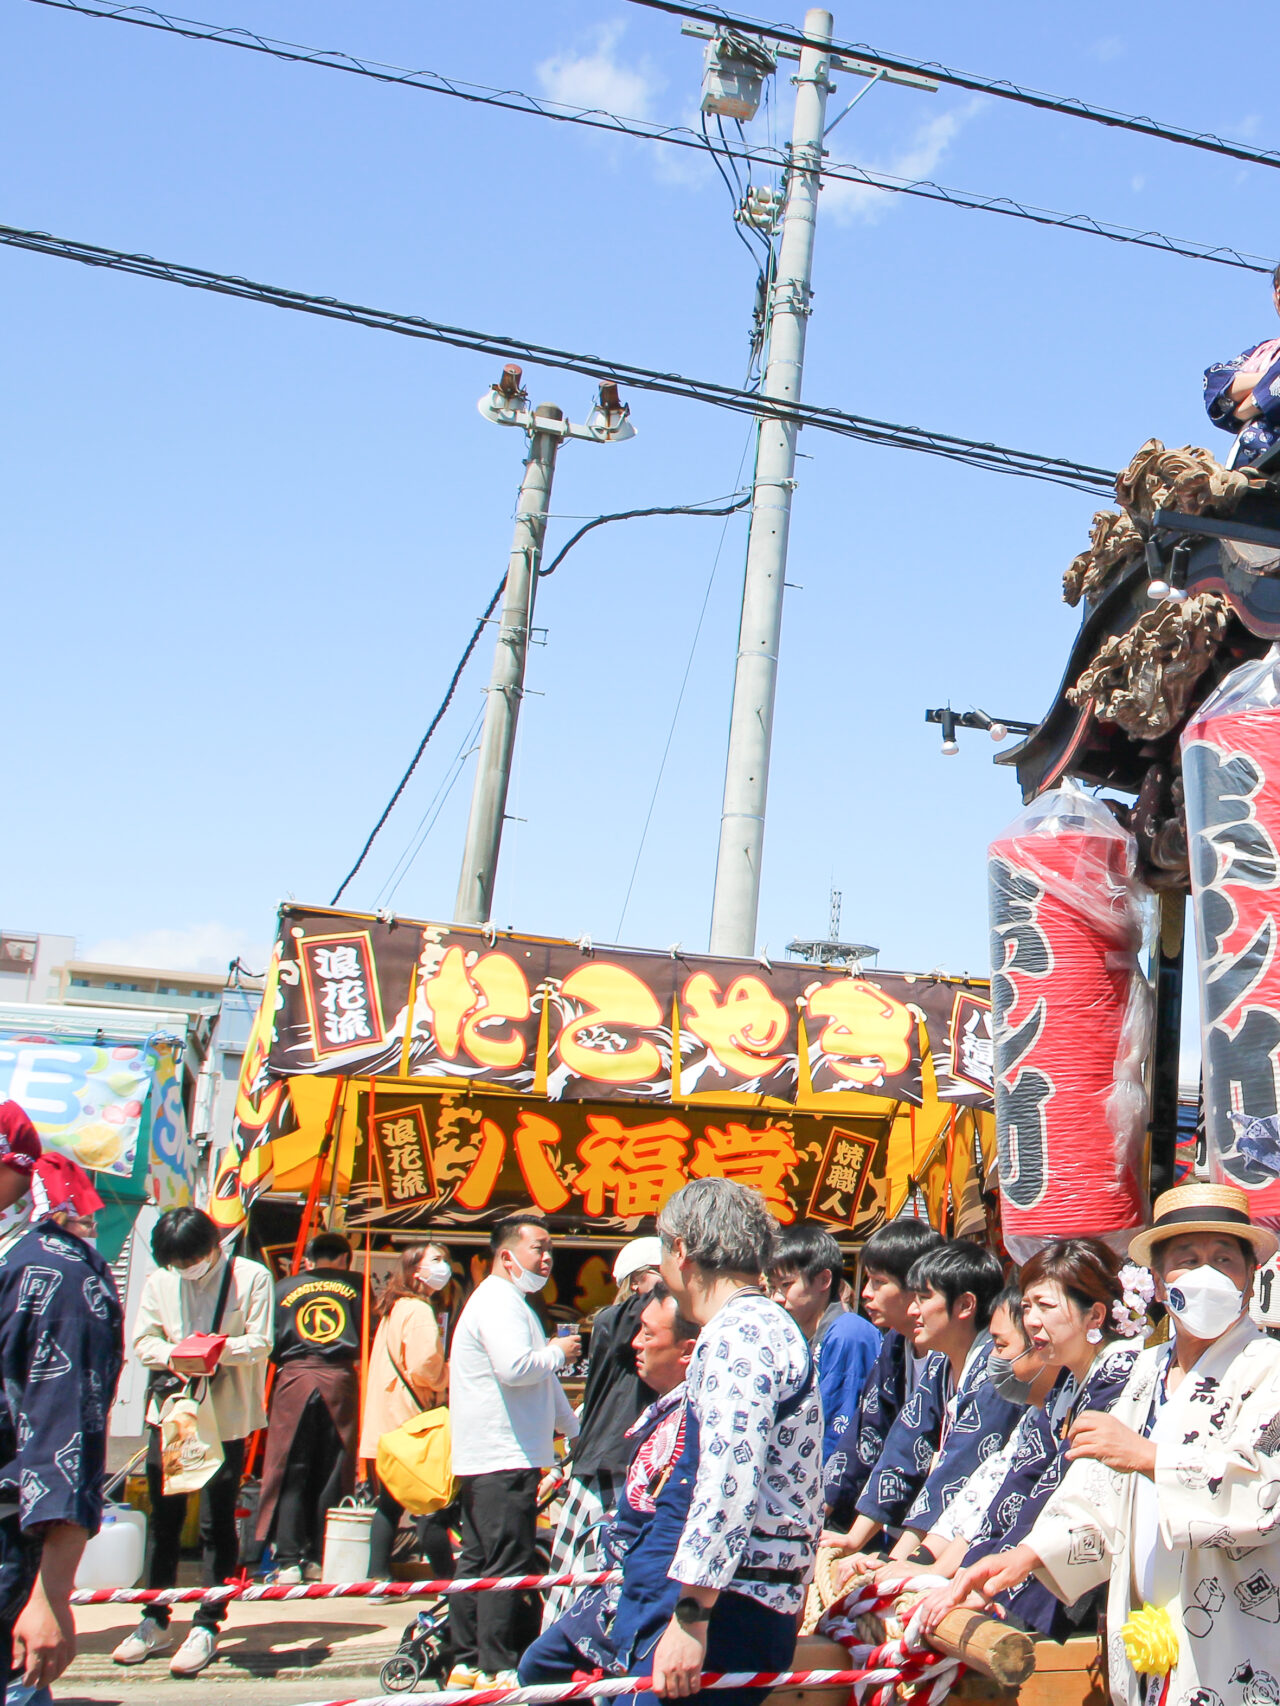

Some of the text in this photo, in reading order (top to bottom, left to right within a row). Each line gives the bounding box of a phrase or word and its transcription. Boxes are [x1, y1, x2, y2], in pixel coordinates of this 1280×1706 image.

[315, 945, 371, 1044] 浪花流
[426, 943, 912, 1086] たこやき
[380, 1119, 428, 1199] 浪花流
[455, 1110, 800, 1226] 八福堂
[819, 1139, 866, 1217] 焼職人
